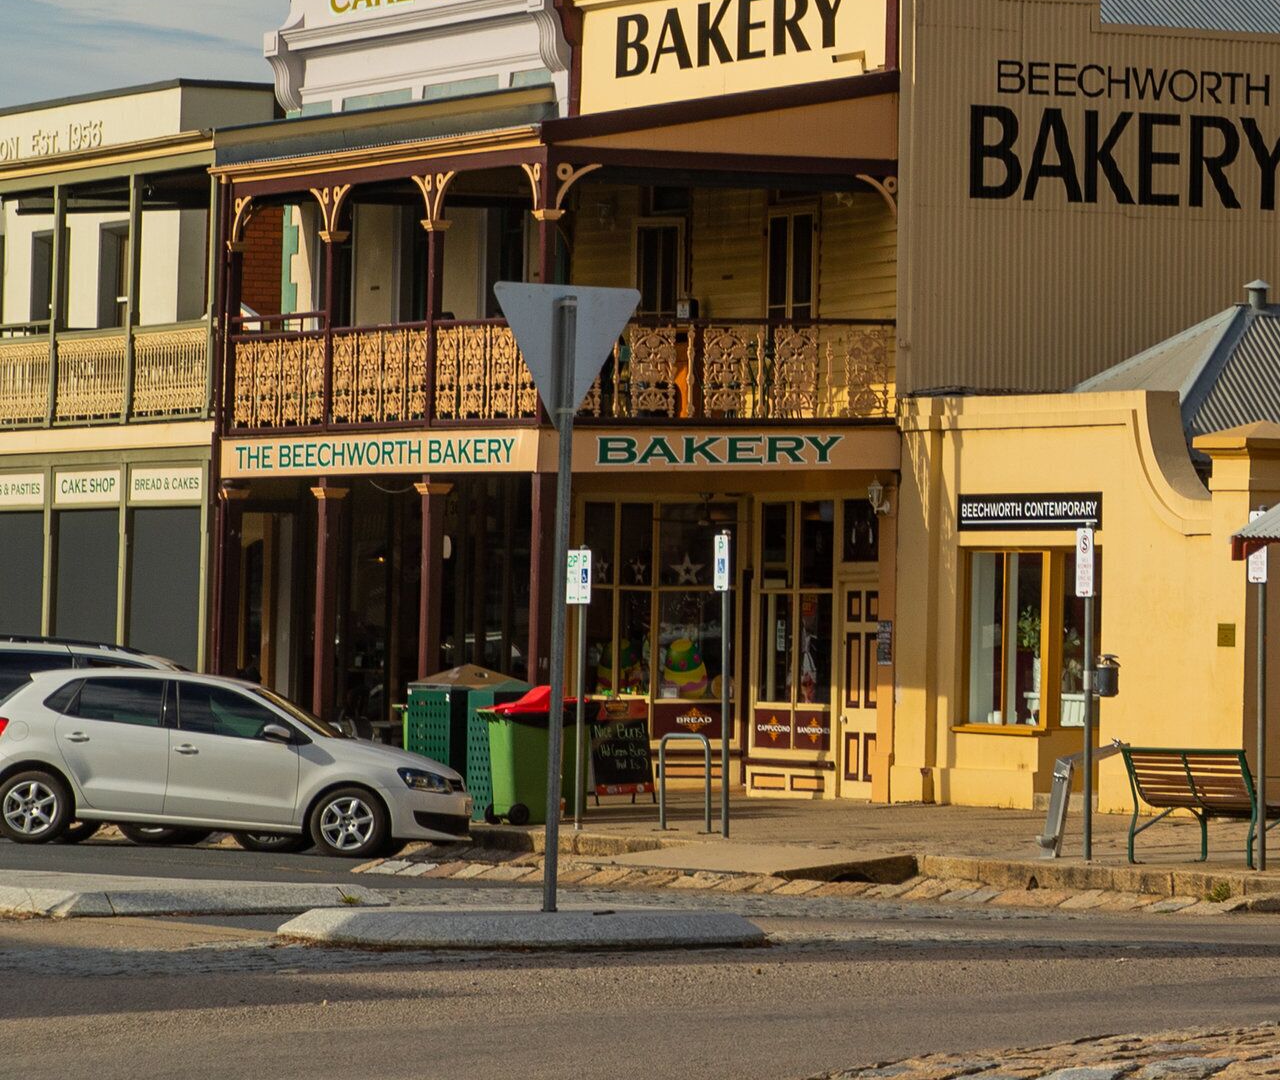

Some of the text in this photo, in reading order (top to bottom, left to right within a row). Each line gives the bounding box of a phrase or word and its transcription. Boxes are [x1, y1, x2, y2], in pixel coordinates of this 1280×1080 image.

[997, 59, 1270, 106] BEECHWORTH
[236, 438, 515, 469] THE BEECHWORTH BAKERY
[596, 435, 845, 465] BAKERY
[3, 483, 9, 496] &
[11, 482, 41, 496] PASTIES
[61, 477, 116, 494] CAKE SHOP
[134, 477, 199, 491] BREAD & CAKES
[961, 501, 1098, 518] BEECHWORTH CONTEMPORARY
[676, 716, 712, 724] BREAD
[757, 723, 791, 733] CAPPUCCINO
